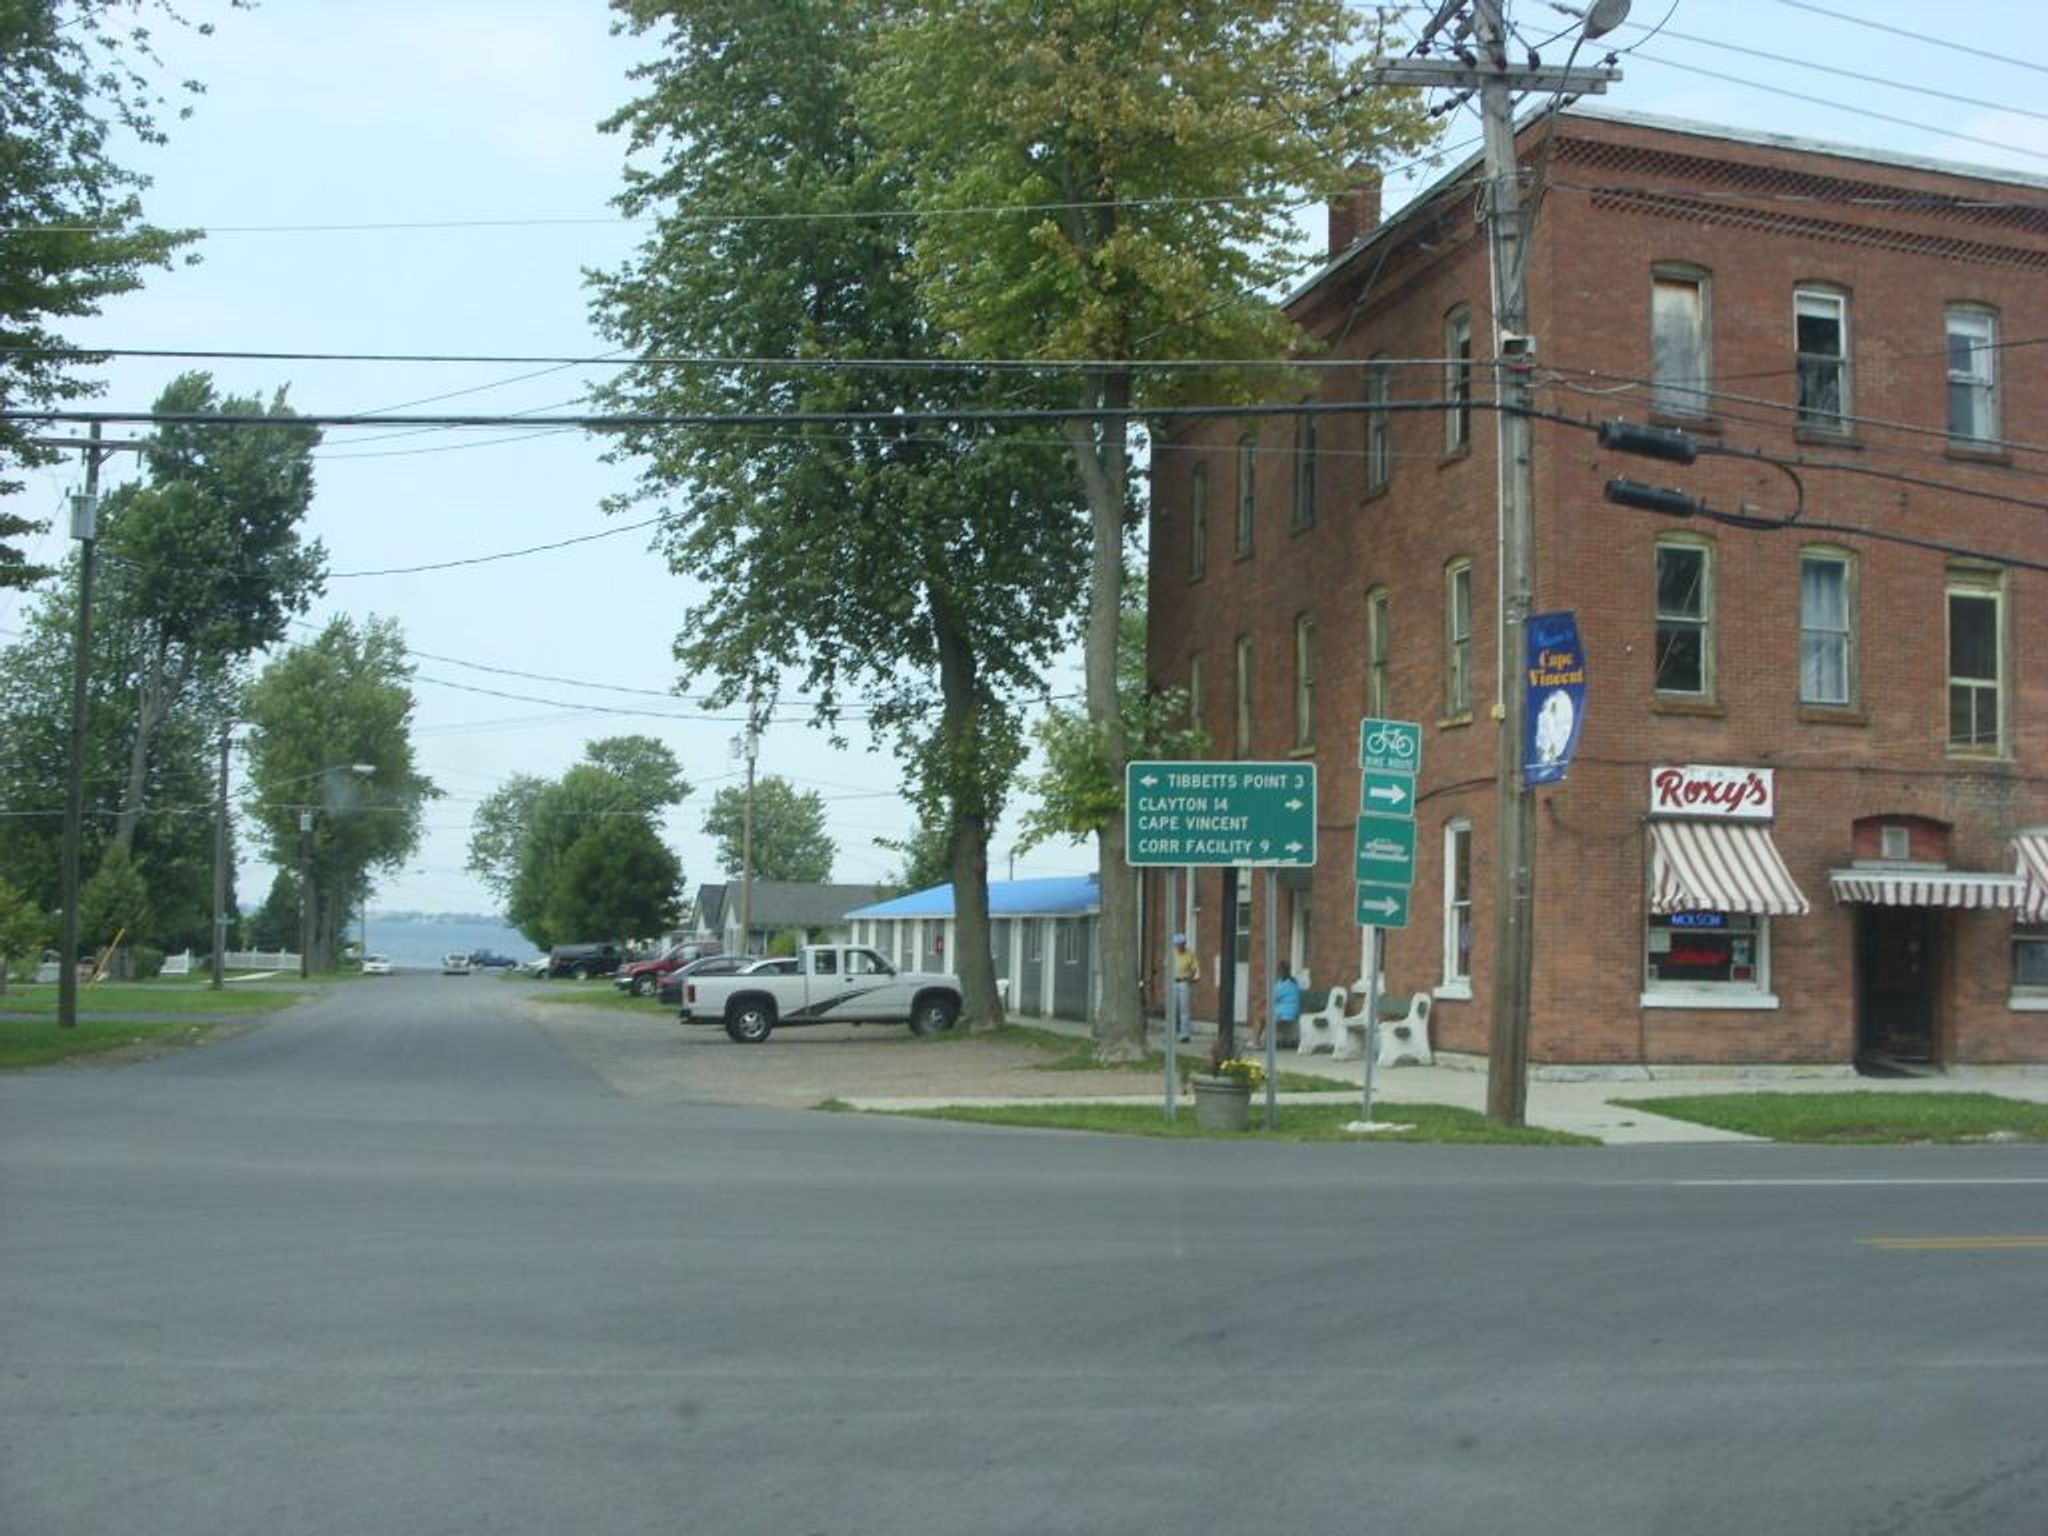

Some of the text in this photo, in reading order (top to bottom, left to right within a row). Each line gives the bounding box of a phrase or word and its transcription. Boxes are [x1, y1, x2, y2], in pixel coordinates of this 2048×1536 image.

[1539, 649, 1574, 671] Cape
[1530, 668, 1584, 686] Vincent
[1168, 774, 1304, 788] TIBBETTS POINT 3
[1656, 770, 1767, 812] Roxy's
[1138, 797, 1228, 811] CLAYTON 14
[1138, 816, 1249, 830] CAPE VINCENT
[1138, 839, 1270, 853] CORR FACILITY 9
